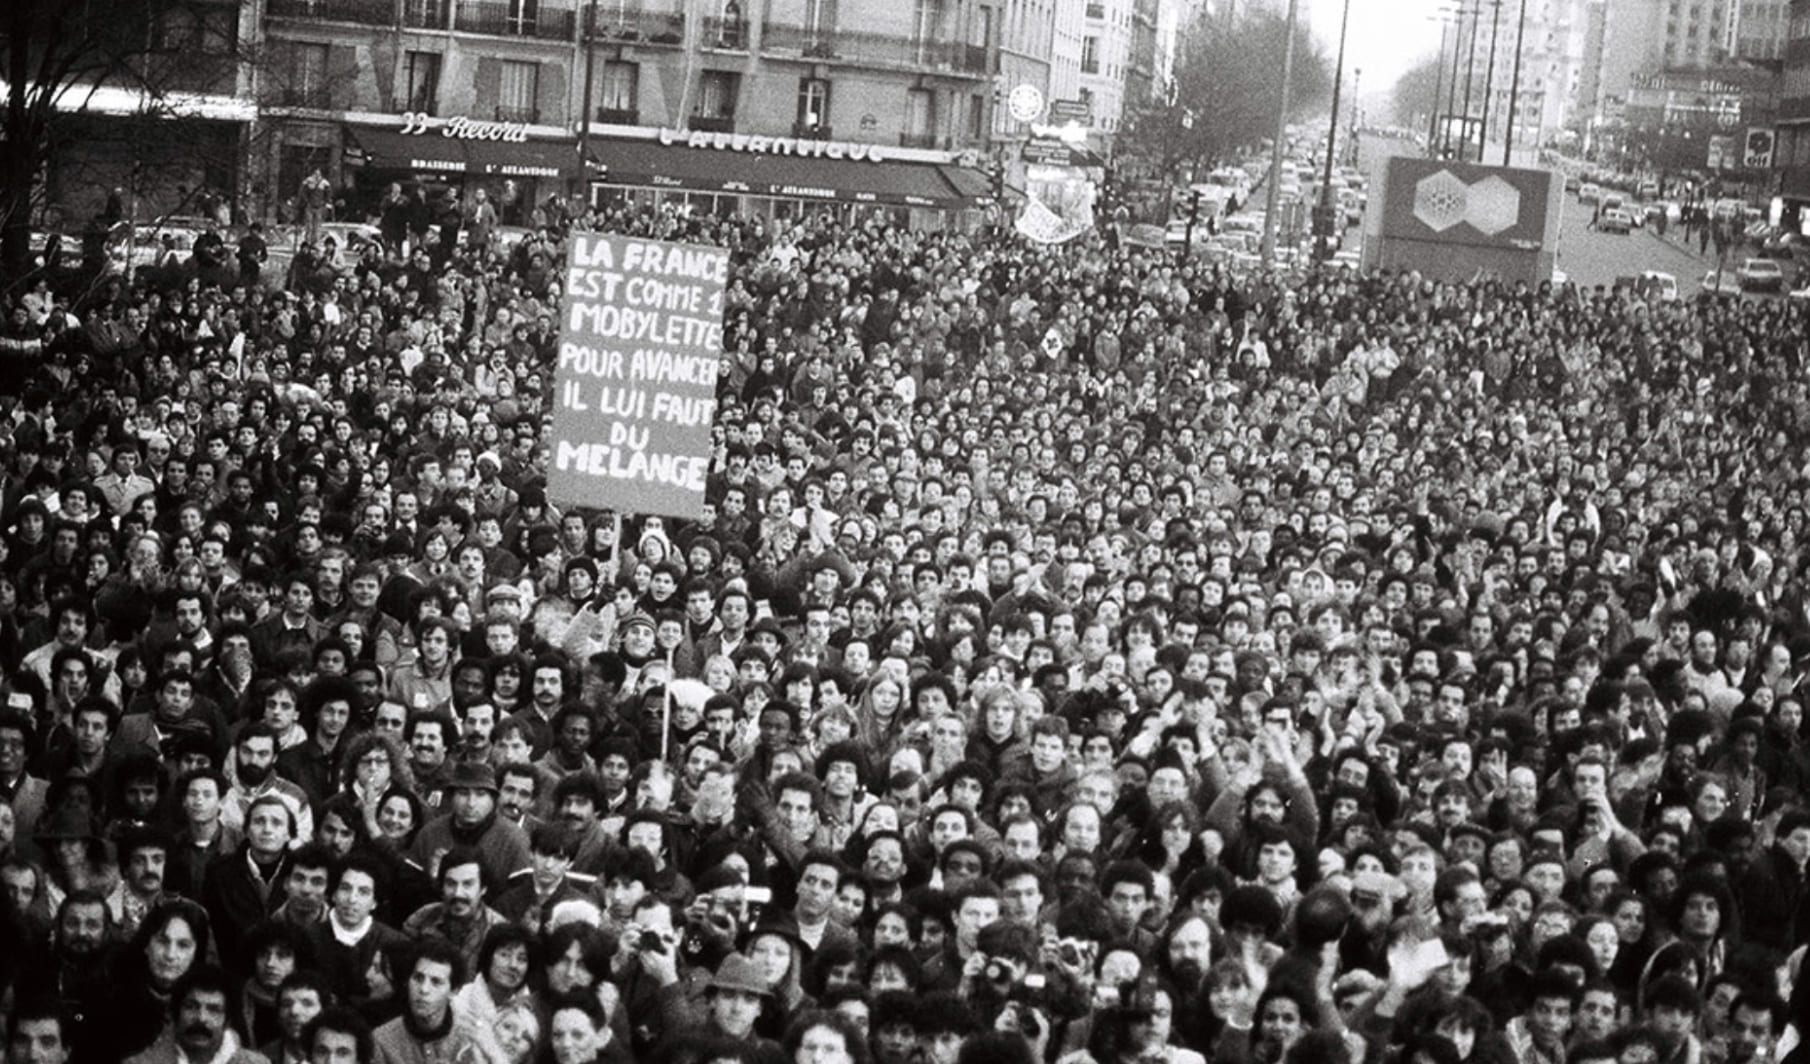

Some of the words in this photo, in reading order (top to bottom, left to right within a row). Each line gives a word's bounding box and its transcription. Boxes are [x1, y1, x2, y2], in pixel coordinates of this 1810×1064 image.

[400, 112, 429, 135] 33
[442, 116, 531, 142] Record
[411, 159, 467, 171] BRASSERIE
[1747, 154, 1768, 168] elf
[574, 237, 614, 269] LA
[623, 242, 729, 285] FRANCE
[568, 267, 624, 302] EST
[625, 277, 704, 312] COMME
[707, 289, 724, 316] 1
[570, 302, 724, 350] MOBYLETTE
[559, 342, 624, 380] POUR
[630, 348, 719, 385] AVANCER
[562, 379, 588, 411] IL
[600, 386, 646, 419] LUI
[651, 392, 719, 426] FAUT
[610, 421, 649, 451] DU
[556, 440, 711, 492] MELANGE
